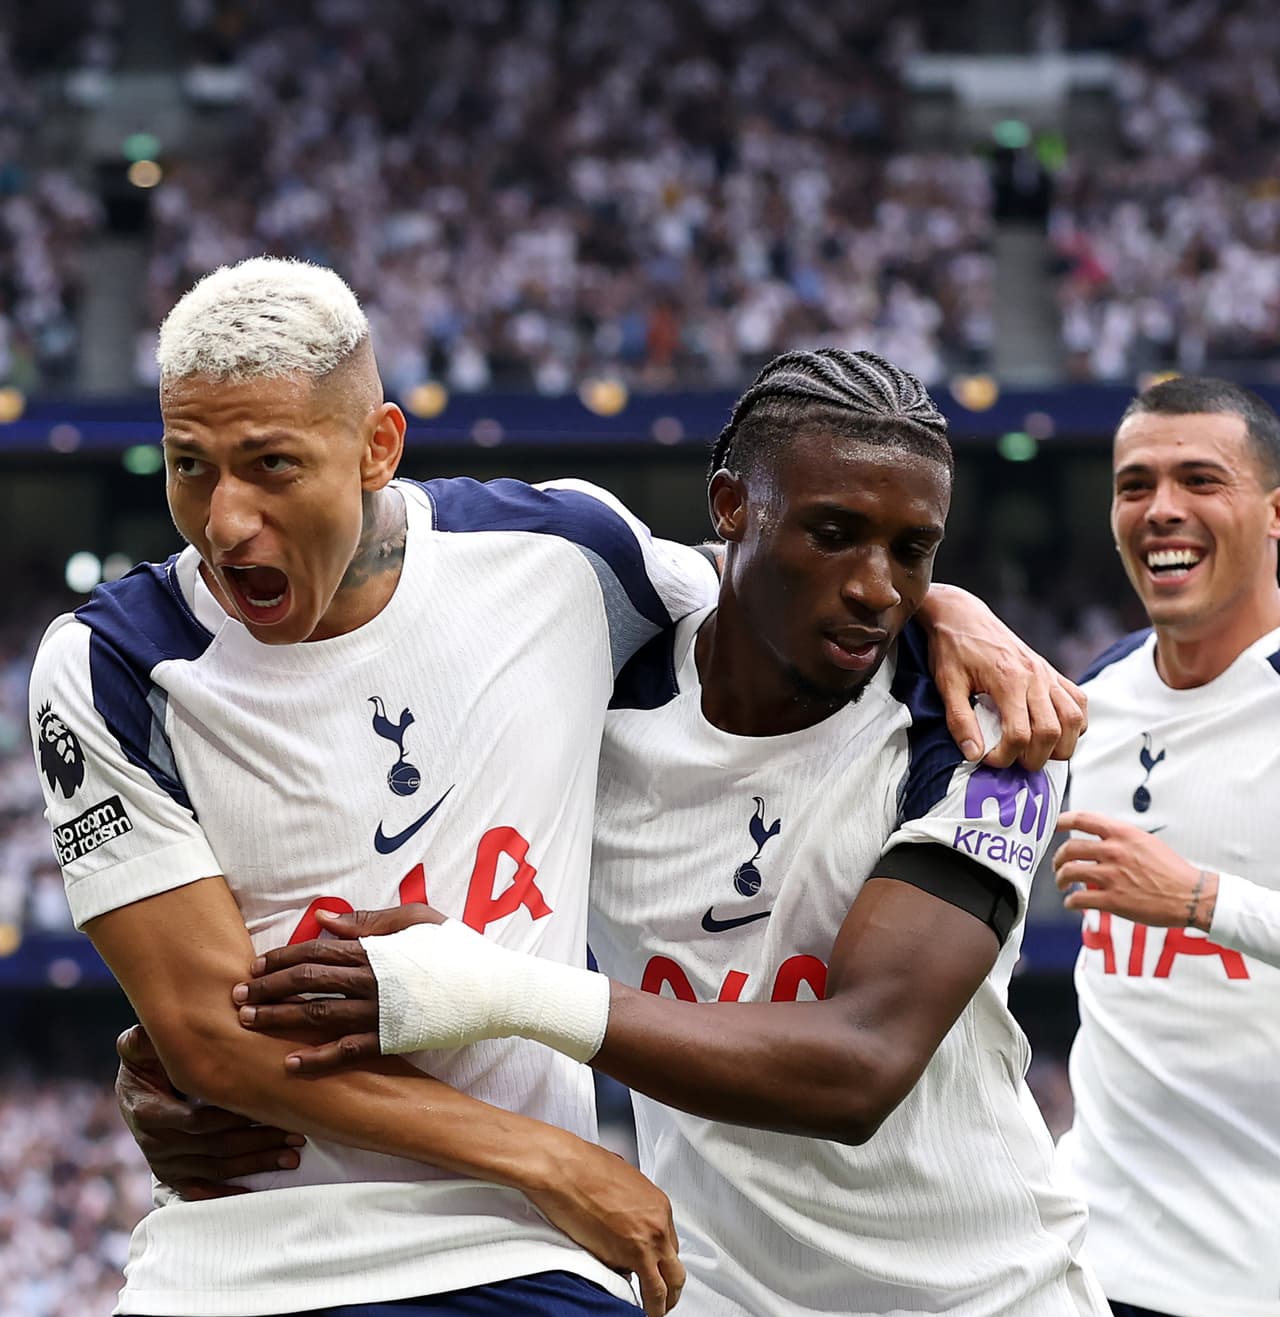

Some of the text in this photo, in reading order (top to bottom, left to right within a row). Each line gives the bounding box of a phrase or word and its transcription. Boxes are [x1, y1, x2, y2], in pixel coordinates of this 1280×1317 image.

[53, 804, 117, 849] No room
[78, 816, 132, 855] racism
[952, 825, 1036, 875] krake
